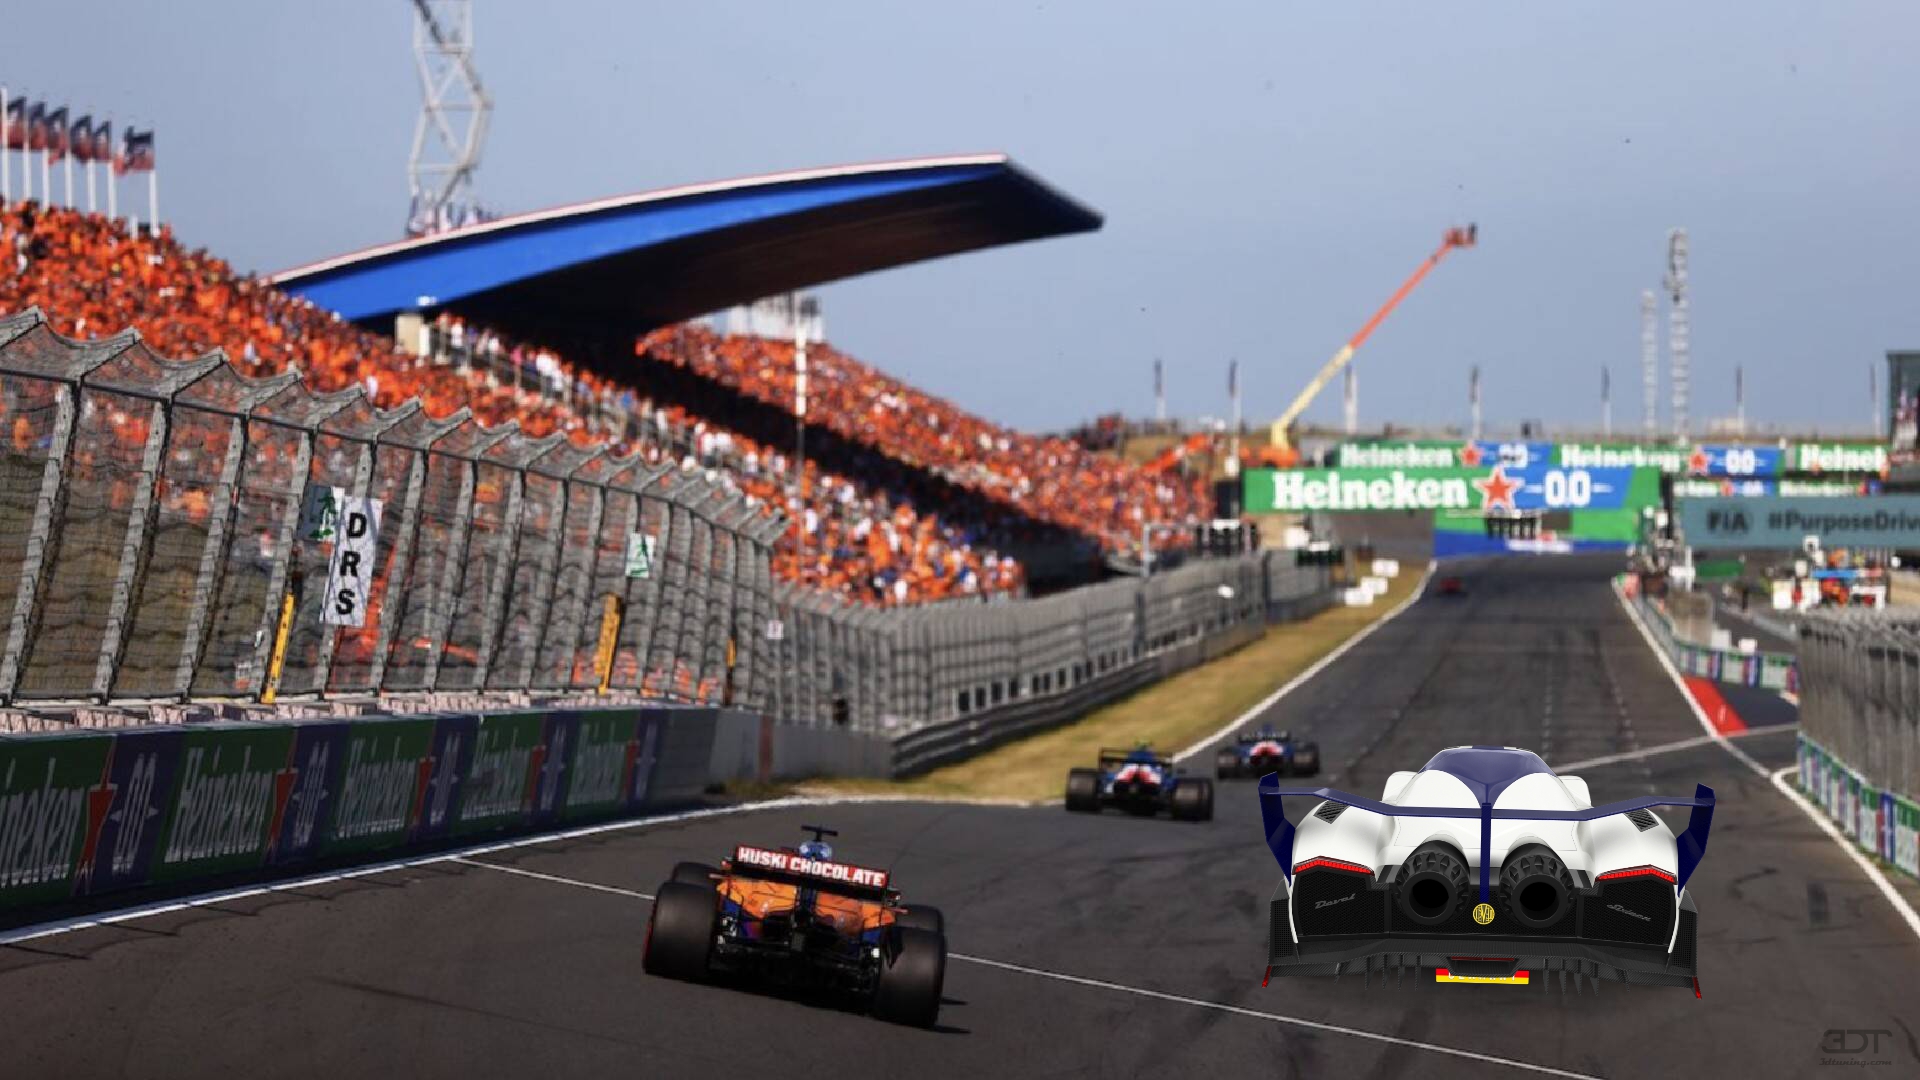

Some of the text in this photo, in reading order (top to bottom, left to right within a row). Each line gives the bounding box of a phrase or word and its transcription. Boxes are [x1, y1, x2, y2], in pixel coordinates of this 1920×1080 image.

[1272, 470, 1469, 509] Heineken
[1768, 509, 1920, 535] #PurposeDriv
[164, 745, 273, 864] Heineken
[738, 847, 886, 887] HUSKI CHOCOLATE
